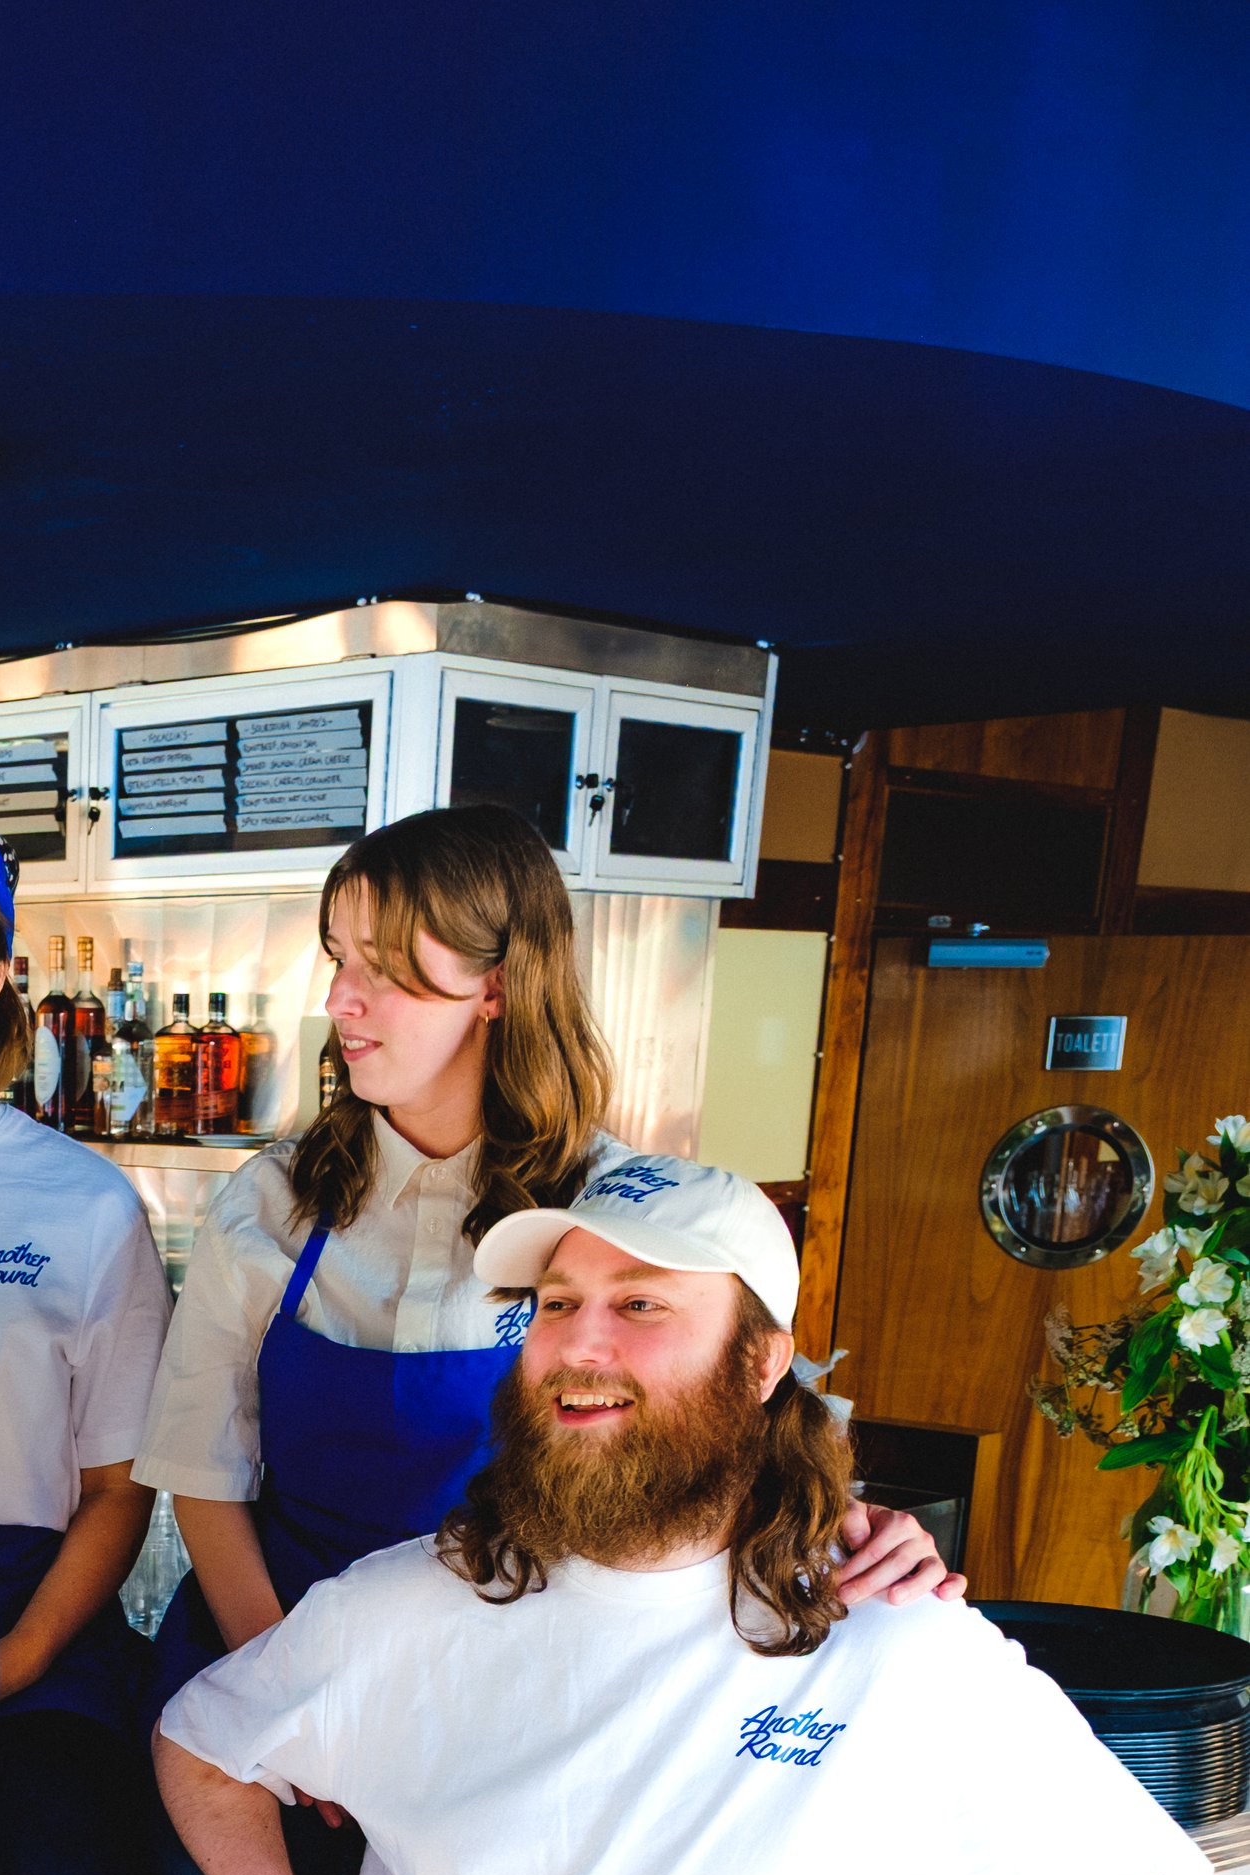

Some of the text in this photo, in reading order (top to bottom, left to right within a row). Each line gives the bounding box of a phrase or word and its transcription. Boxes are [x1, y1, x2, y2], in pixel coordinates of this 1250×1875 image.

[1056, 1033, 1119, 1053] TOALETT
[740, 1705, 847, 1740] Another
[735, 1730, 834, 1766] Round
